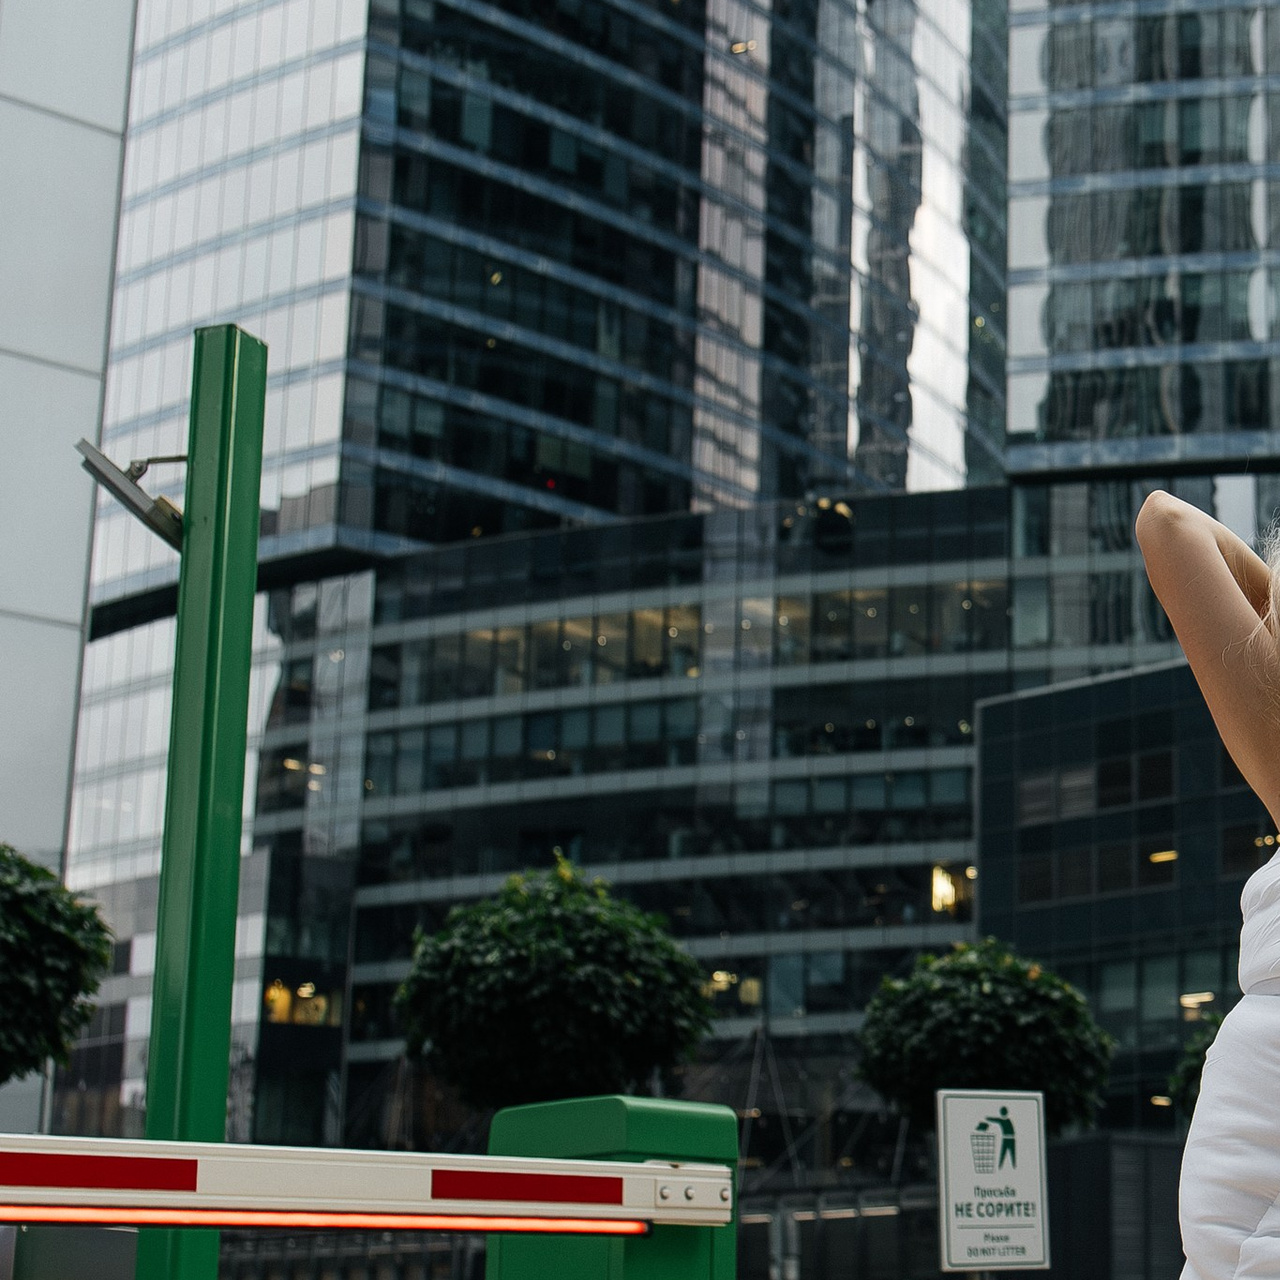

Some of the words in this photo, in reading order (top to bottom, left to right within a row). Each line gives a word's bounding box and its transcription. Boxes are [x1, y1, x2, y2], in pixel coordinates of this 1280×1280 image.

[974, 1186, 1016, 1199] Просьба
[955, 1202, 972, 1218] НЕ
[976, 1202, 1036, 1218] СОРИТЕ!
